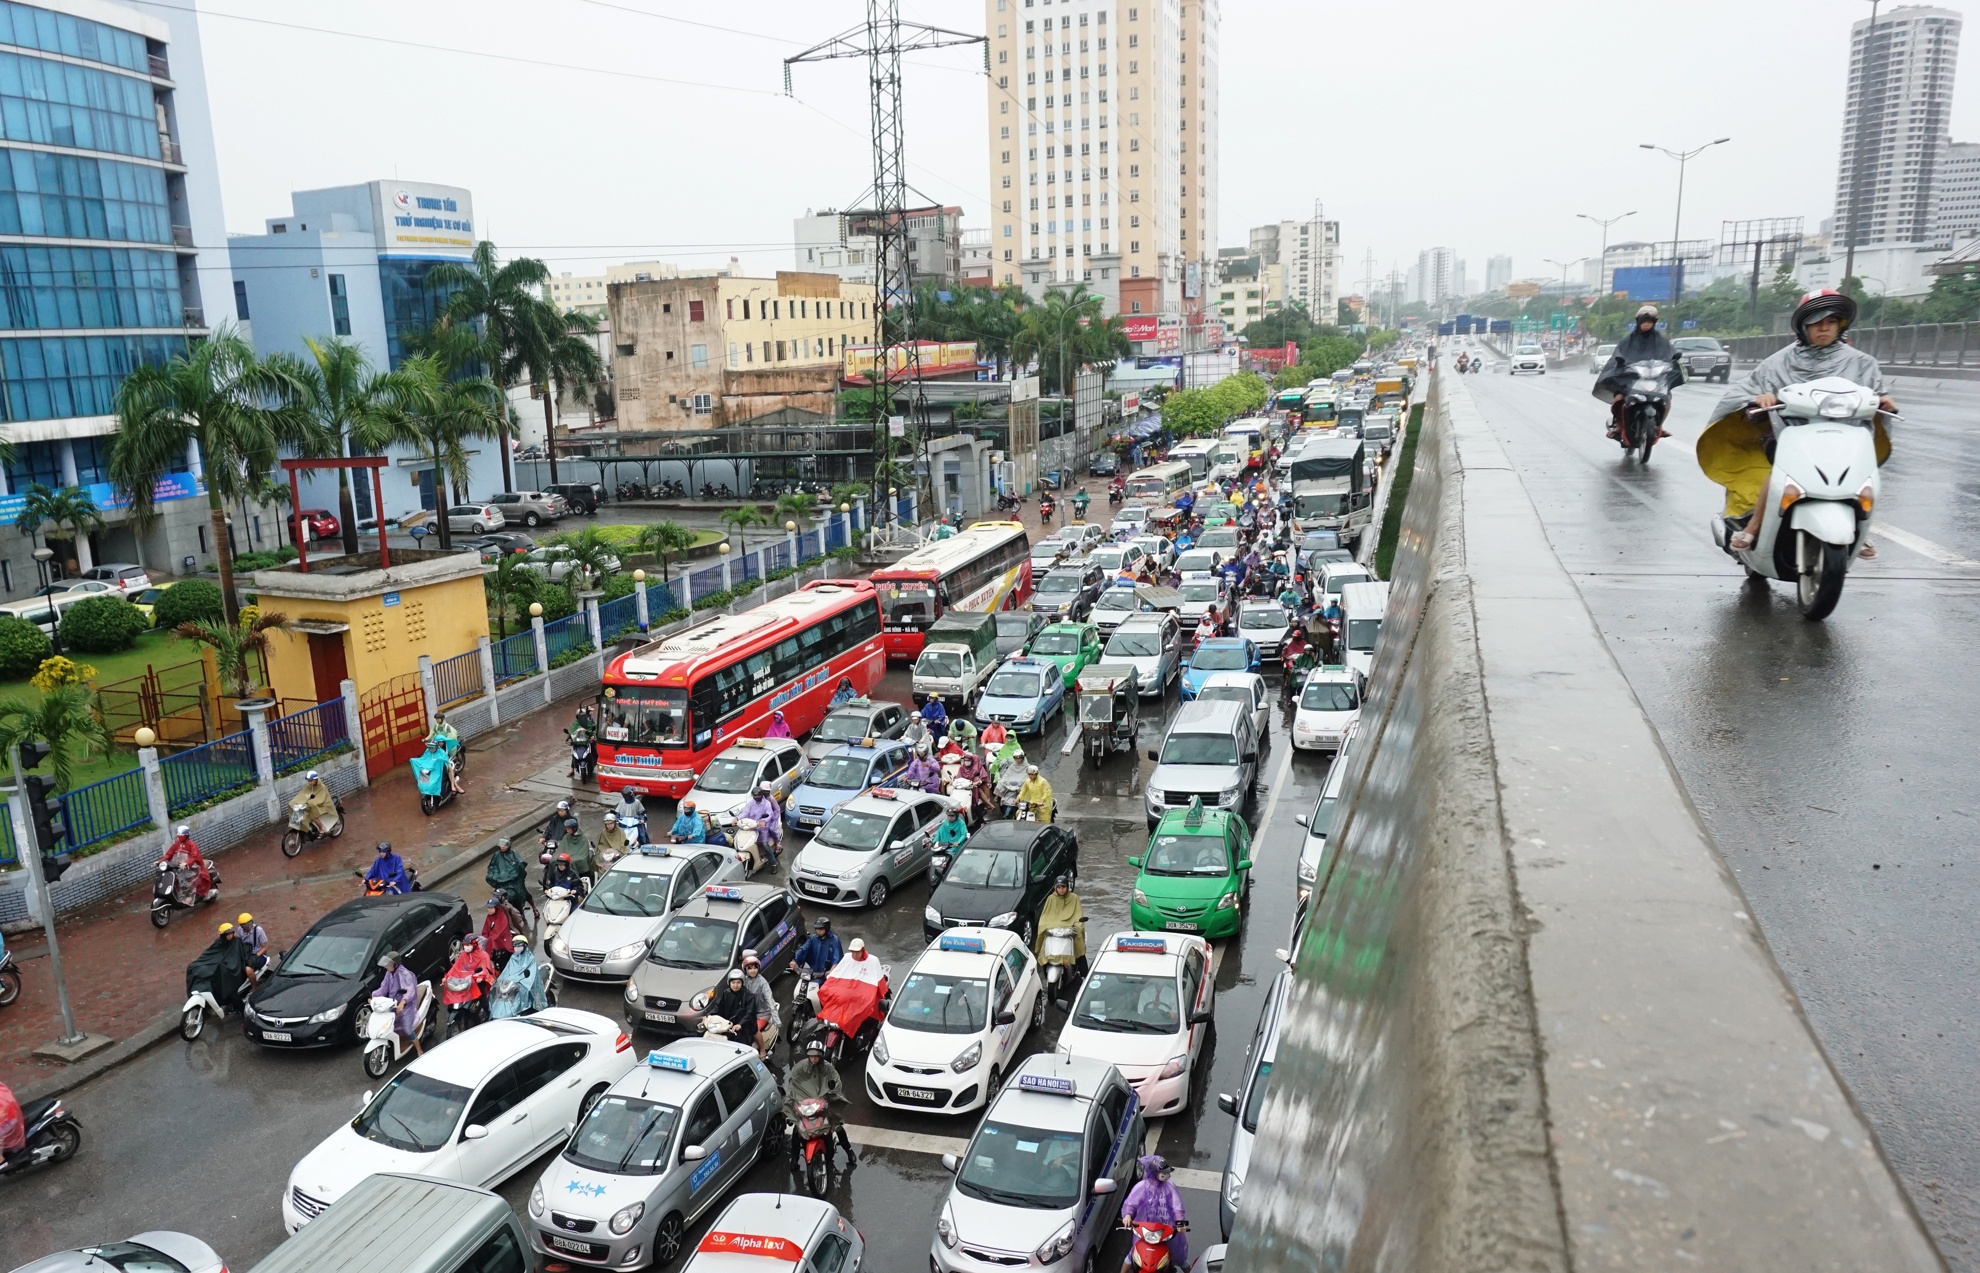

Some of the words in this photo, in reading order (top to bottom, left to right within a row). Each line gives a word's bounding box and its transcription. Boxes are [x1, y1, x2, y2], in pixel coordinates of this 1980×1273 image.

[416, 197, 442, 210] TRUNG
[413, 216, 443, 230] NGHIỆM
[444, 219, 452, 230] XE
[1140, 324, 1156, 333] Mart
[875, 581, 897, 592] PHÚC
[901, 580, 929, 591] XUYÊN
[968, 596, 980, 610] PHÚC
[980, 586, 995, 604] XUYÊN
[607, 729, 620, 739] NGHỆ
[1022, 1076, 1036, 1085] SAO
[1037, 1078, 1059, 1088] HANOI
